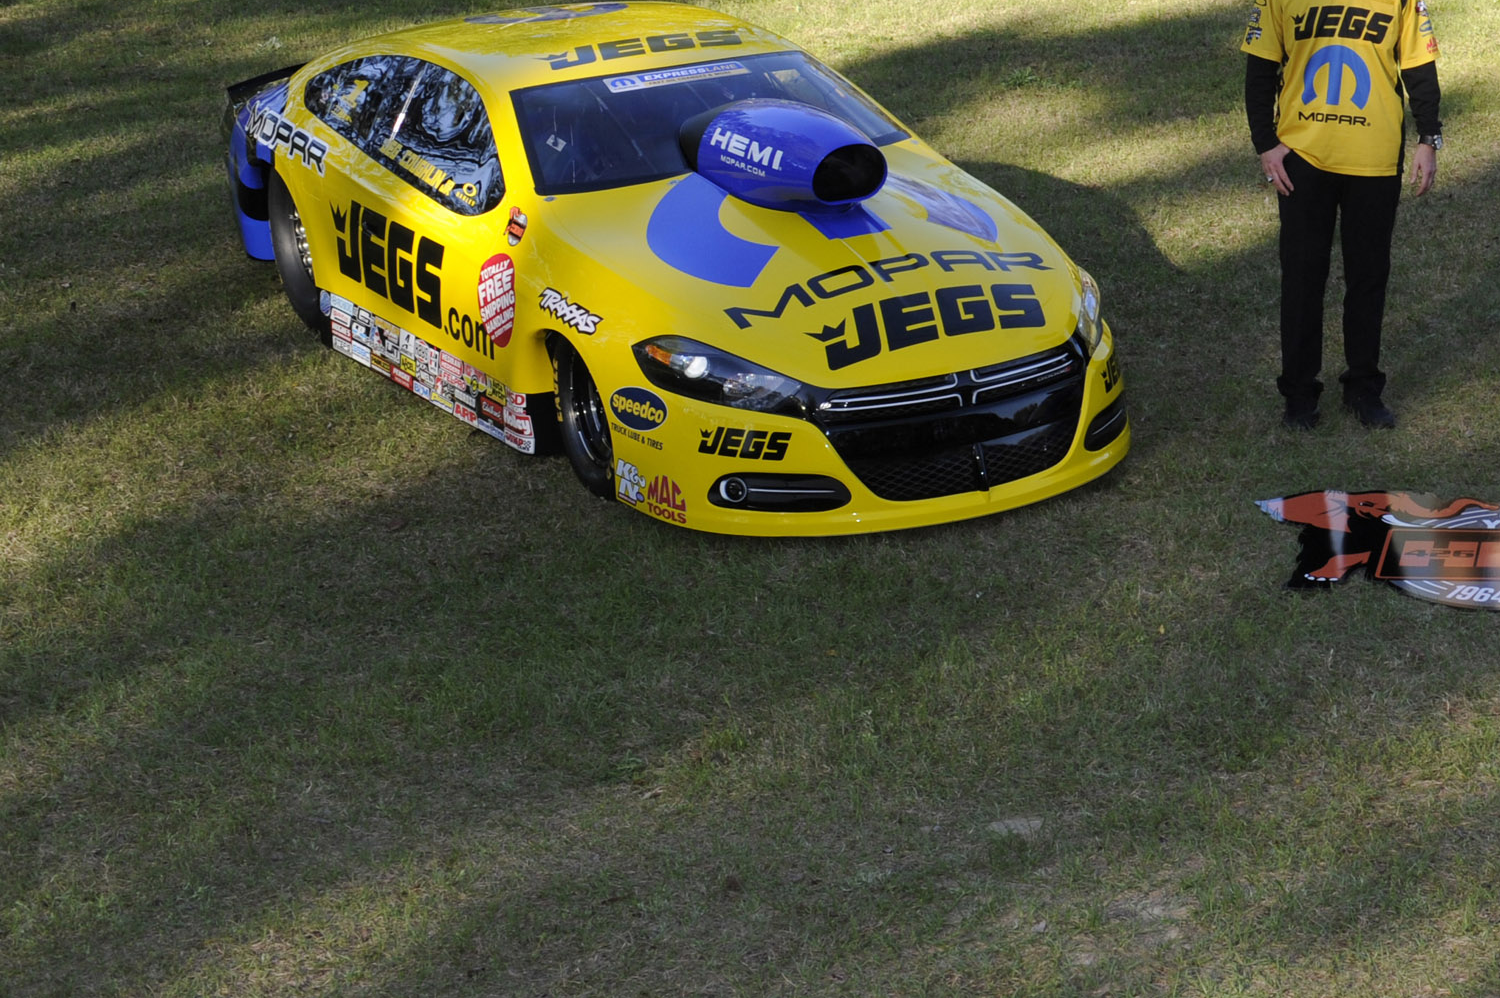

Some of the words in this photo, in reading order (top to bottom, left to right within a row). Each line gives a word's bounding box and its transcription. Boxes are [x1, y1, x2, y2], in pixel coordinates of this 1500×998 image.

[1293, 5, 1394, 44] JEGS
[547, 30, 743, 71] JEGS
[1298, 112, 1368, 126] MOPAR
[245, 100, 327, 177] MOPAR
[710, 127, 784, 171] HEMI
[721, 154, 767, 178] MOPAR.COM
[478, 267, 513, 306] FREE
[480, 259, 511, 282] TOTALLY
[481, 290, 515, 322] SHIPPING
[723, 250, 1056, 330] MOPAR
[485, 307, 514, 335] HANDLING
[539, 288, 602, 334] TRAXXAS
[825, 284, 1046, 371] JEGS
[612, 393, 665, 424] speedco
[611, 422, 627, 436] TRUCK
[627, 430, 641, 444] LUBE
[647, 437, 664, 450] TIRES
[698, 426, 792, 461] JEGS
[647, 475, 687, 512] MAC
[647, 502, 687, 525] TOOLS
[1404, 548, 1476, 558] 426
